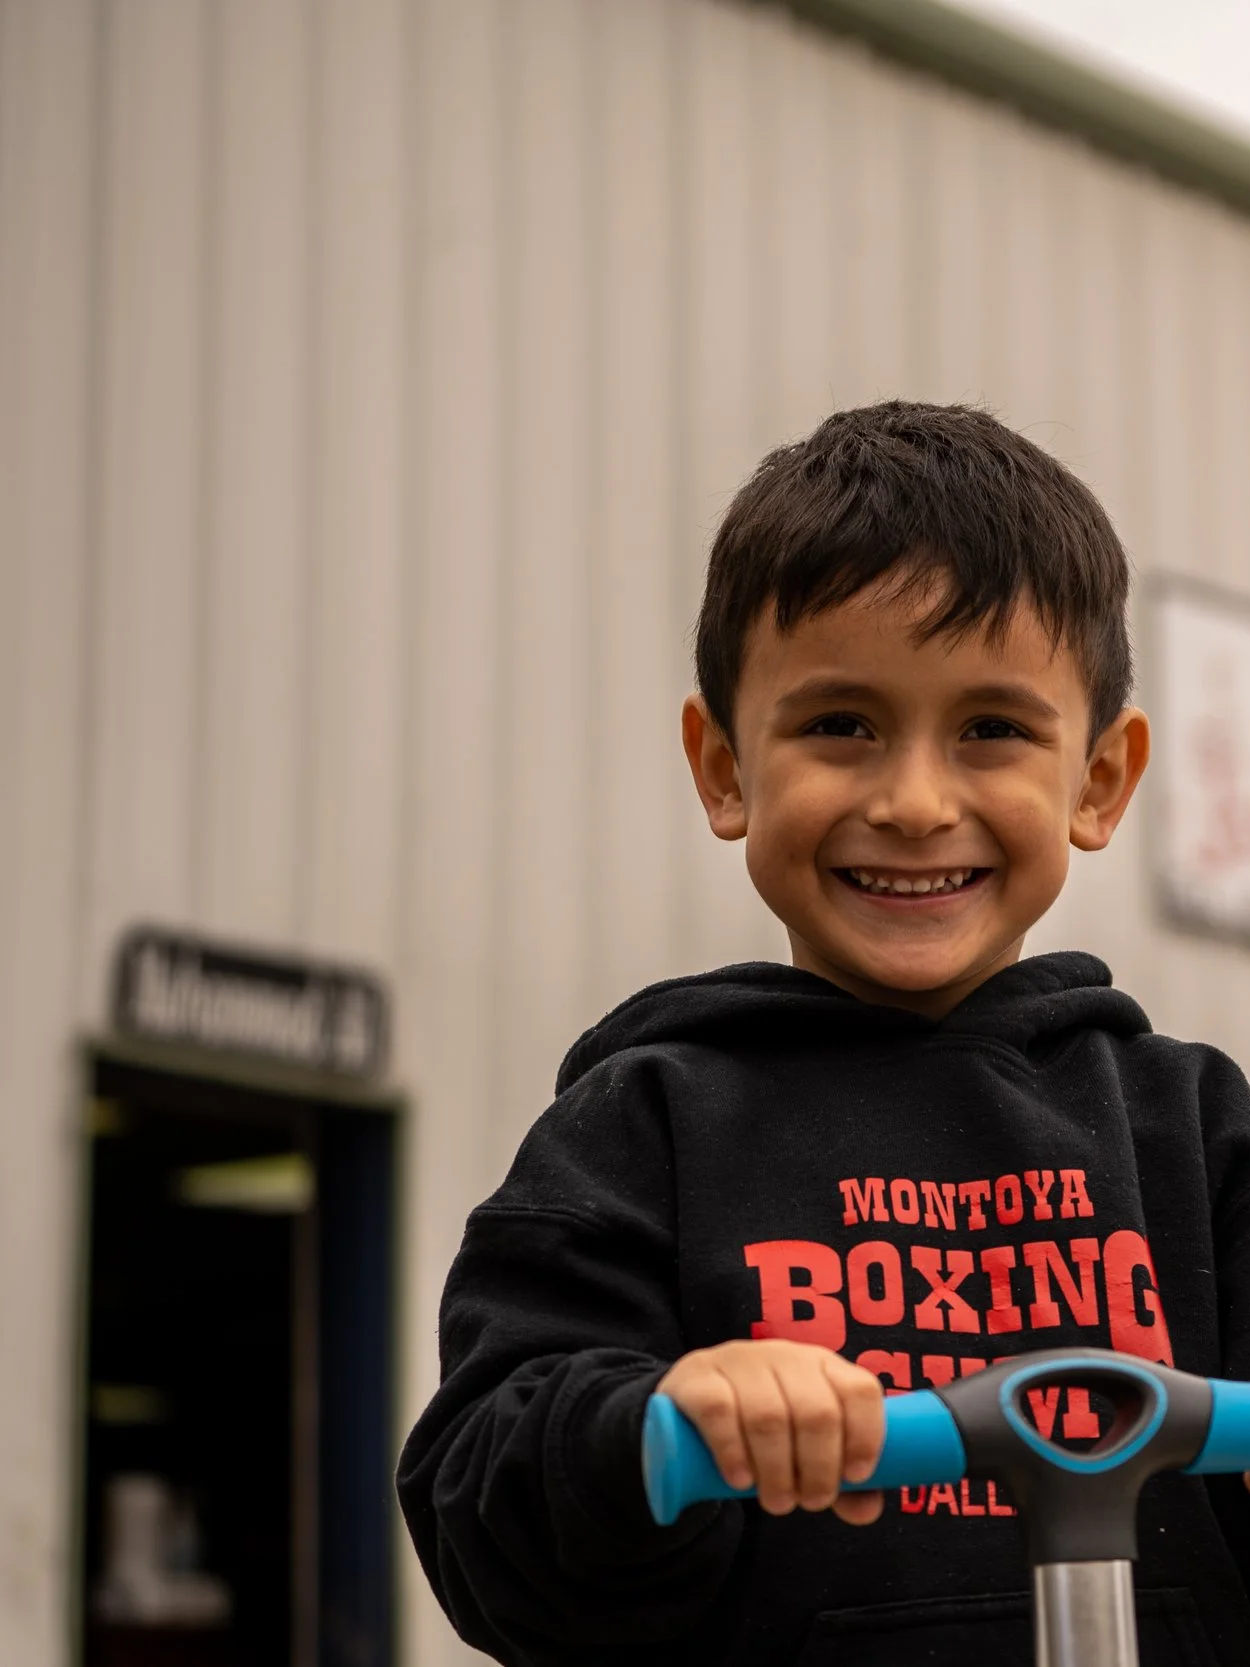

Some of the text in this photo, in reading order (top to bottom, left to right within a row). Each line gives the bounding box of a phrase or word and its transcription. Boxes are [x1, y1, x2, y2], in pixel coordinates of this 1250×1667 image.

[838, 1169, 1095, 1231] MONTOYA
[743, 1229, 1175, 1370] BOXING
[899, 1478, 1018, 1517] DALL
